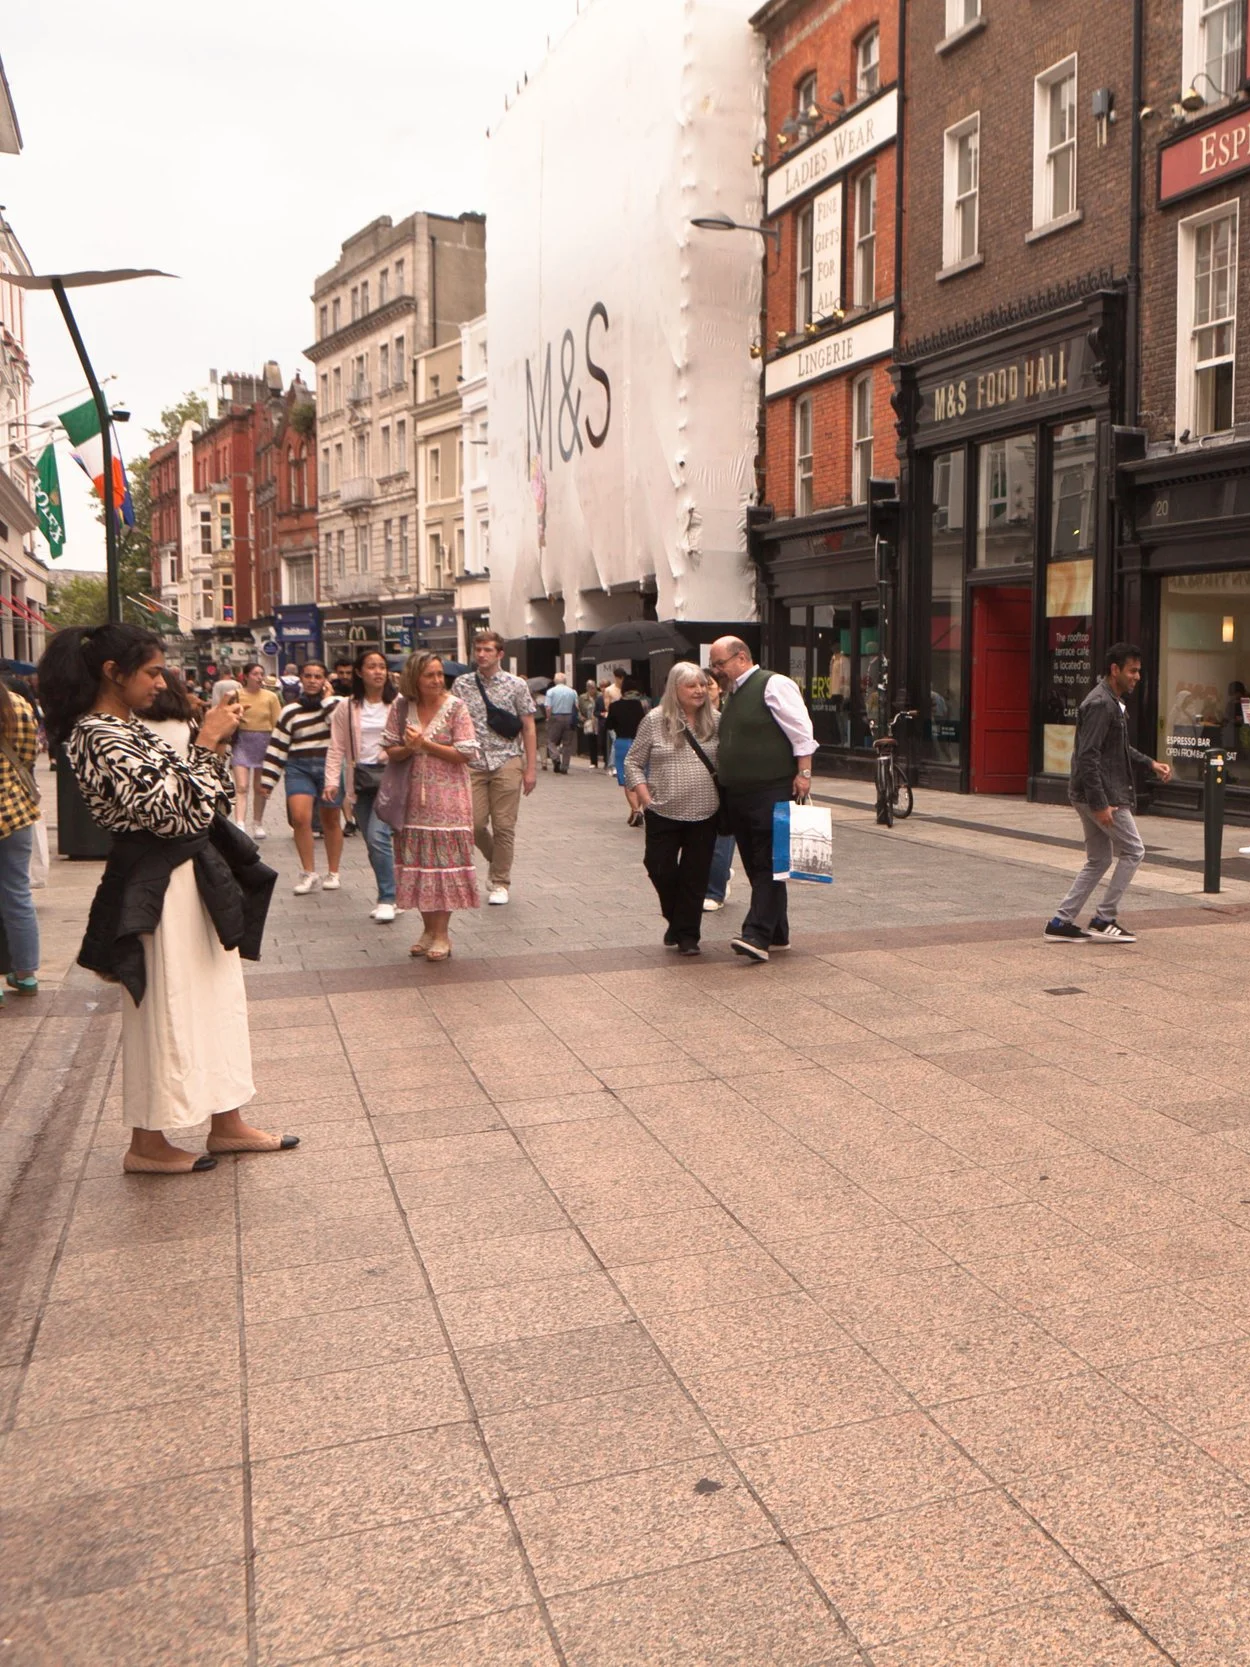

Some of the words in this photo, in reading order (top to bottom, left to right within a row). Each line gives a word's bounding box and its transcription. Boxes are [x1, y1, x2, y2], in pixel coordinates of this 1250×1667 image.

[785, 147, 829, 196] LADIES
[832, 117, 876, 161] WEAR
[817, 196, 838, 223] FINE
[814, 226, 840, 254] GIFTS
[817, 259, 836, 282] FOR
[797, 337, 854, 378] LINGERIE
[525, 300, 612, 482] M&S
[934, 380, 967, 422] M&S
[976, 365, 1018, 411] FOOD
[1024, 351, 1068, 398] HALL
[1155, 500, 1169, 516] 20
[1056, 632, 1066, 642] The
[1067, 632, 1090, 643] rooftop
[1055, 647, 1075, 656] terrace
[1053, 660, 1058, 670] is
[1060, 660, 1081, 670] located
[1082, 662, 1091, 670] on
[1053, 674, 1063, 683] the
[1064, 675, 1074, 685] top
[1075, 674, 1090, 684] floor
[1166, 735, 1197, 746] ESPRESSO
[1197, 737, 1211, 747] BAR
[1165, 747, 1181, 757] OPEN
[1181, 748, 1197, 758] FROM
[1226, 751, 1238, 761] SAT
